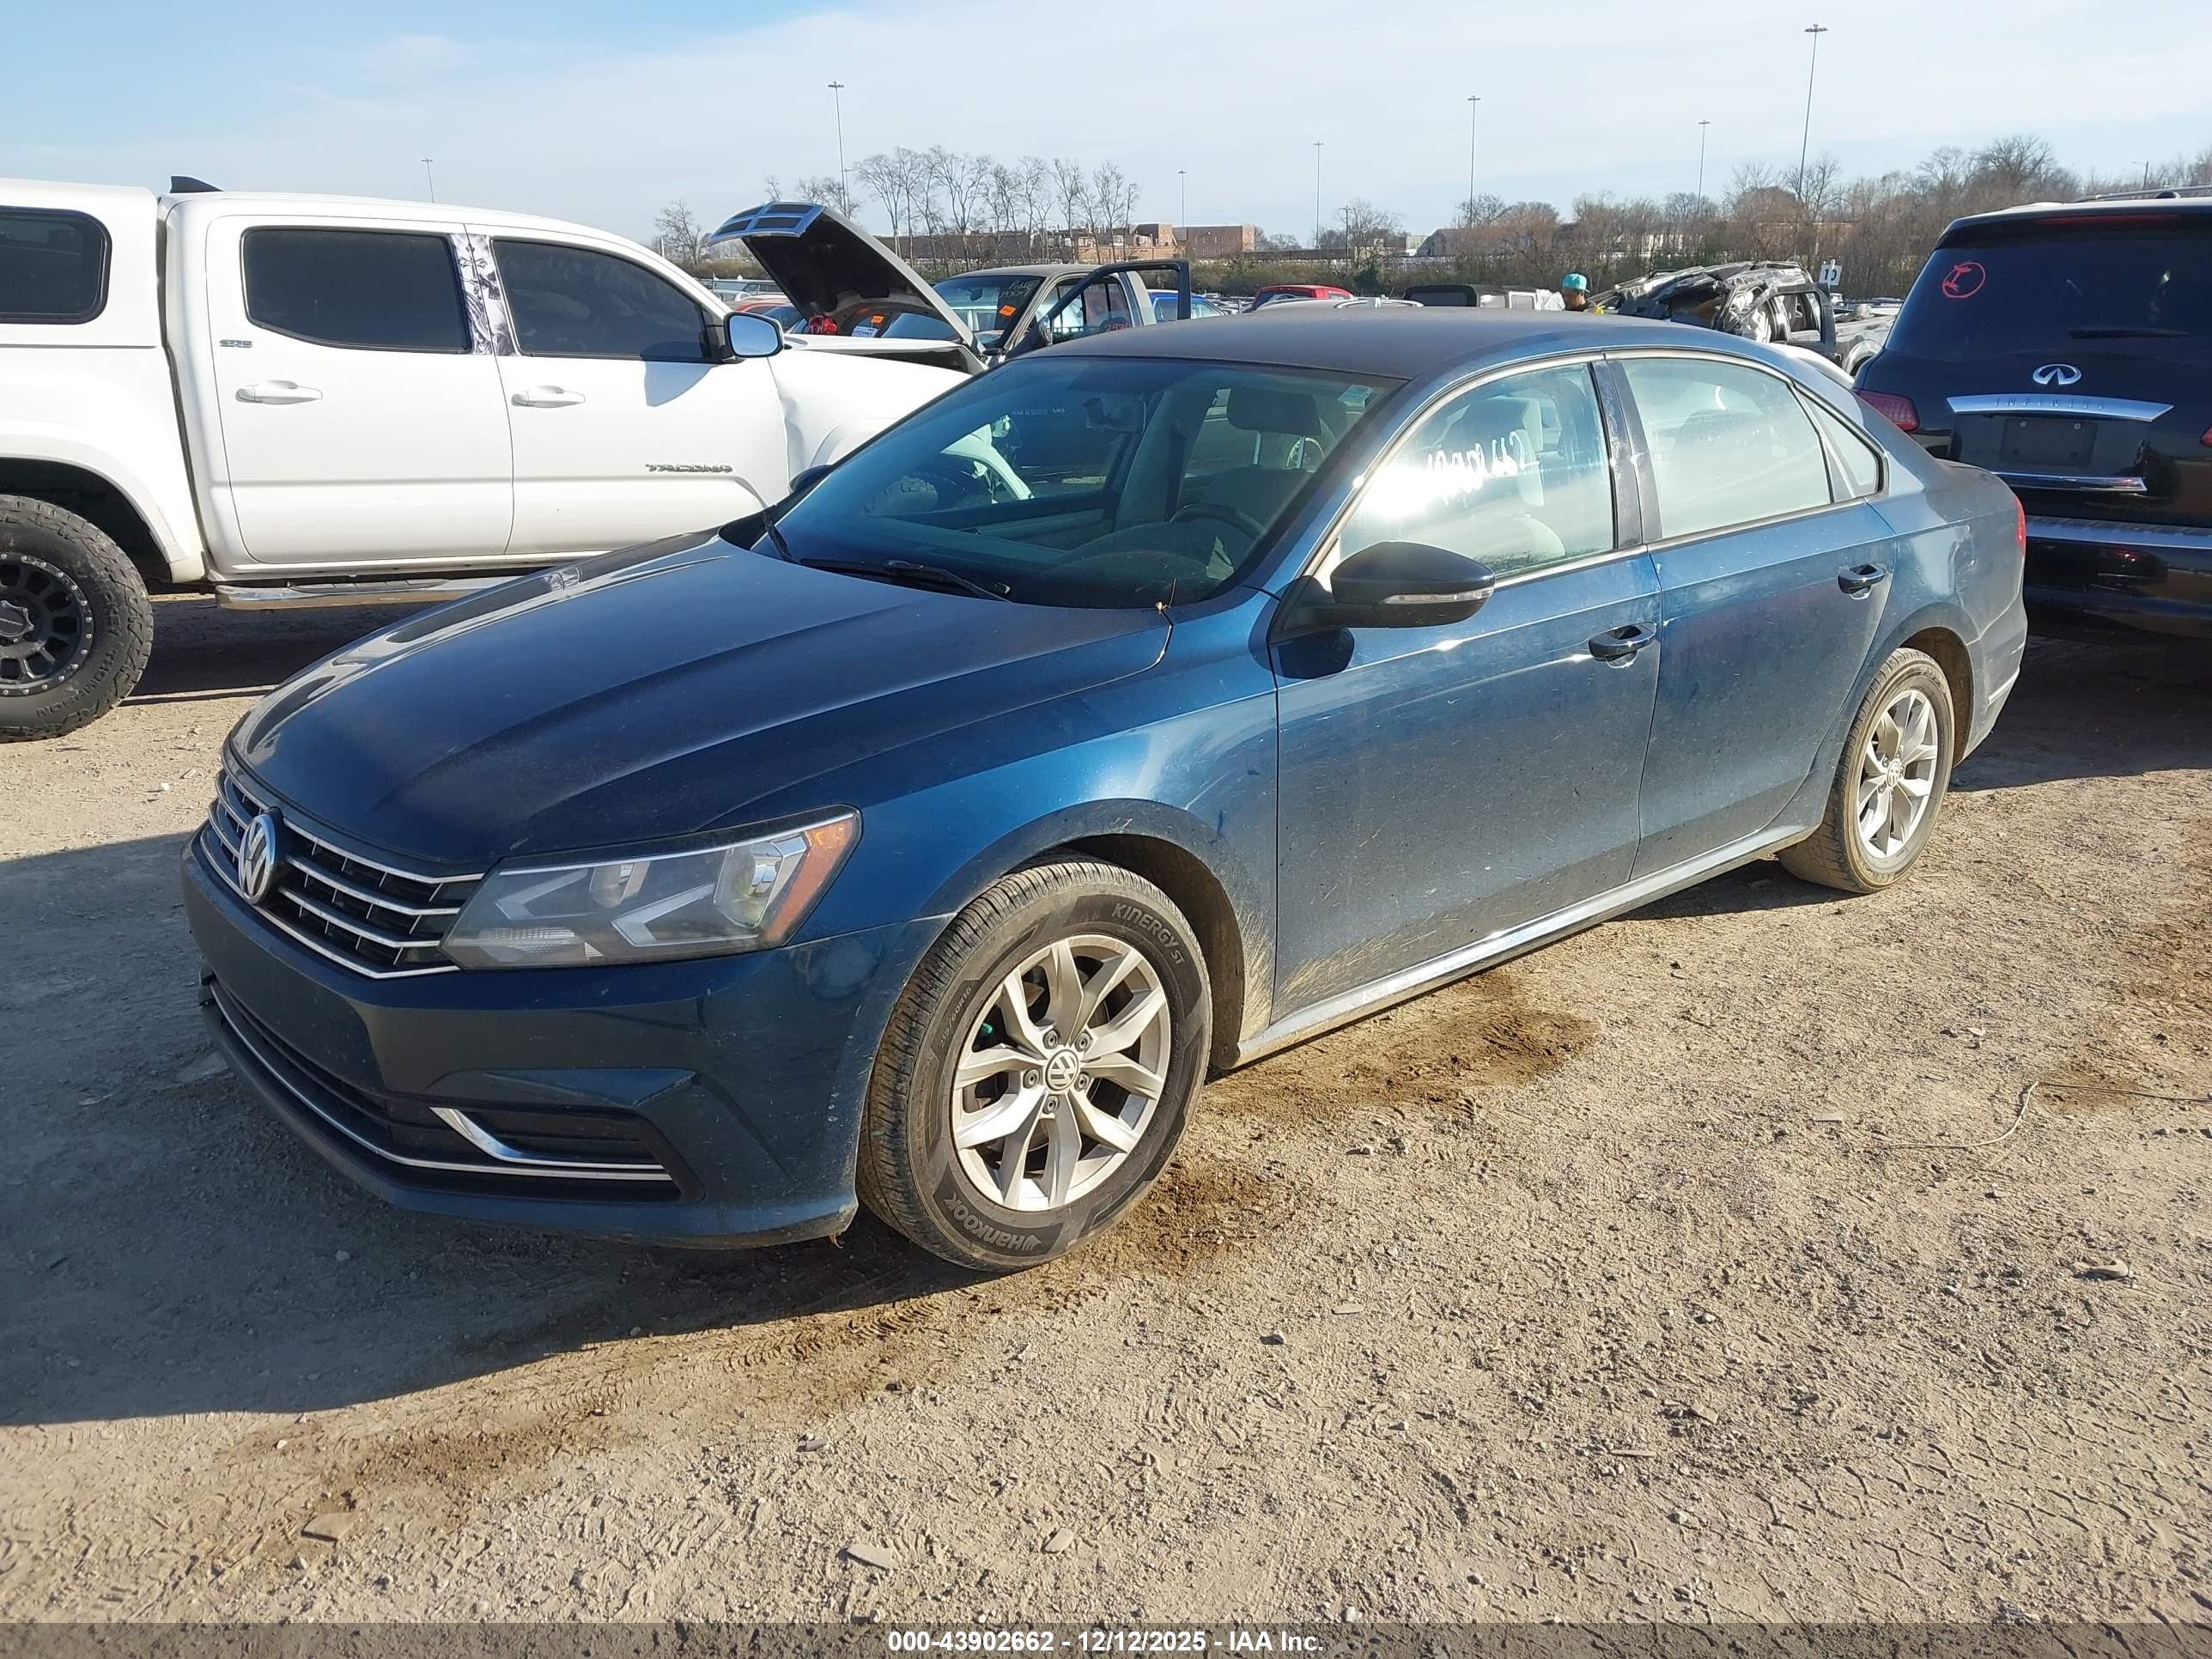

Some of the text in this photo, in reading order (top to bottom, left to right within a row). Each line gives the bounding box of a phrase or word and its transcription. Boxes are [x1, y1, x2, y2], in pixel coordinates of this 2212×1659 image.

[1993, 398, 2103, 410] INFINITI
[645, 464, 733, 473] TACOMA
[1111, 902, 1185, 963] KINERGY ST
